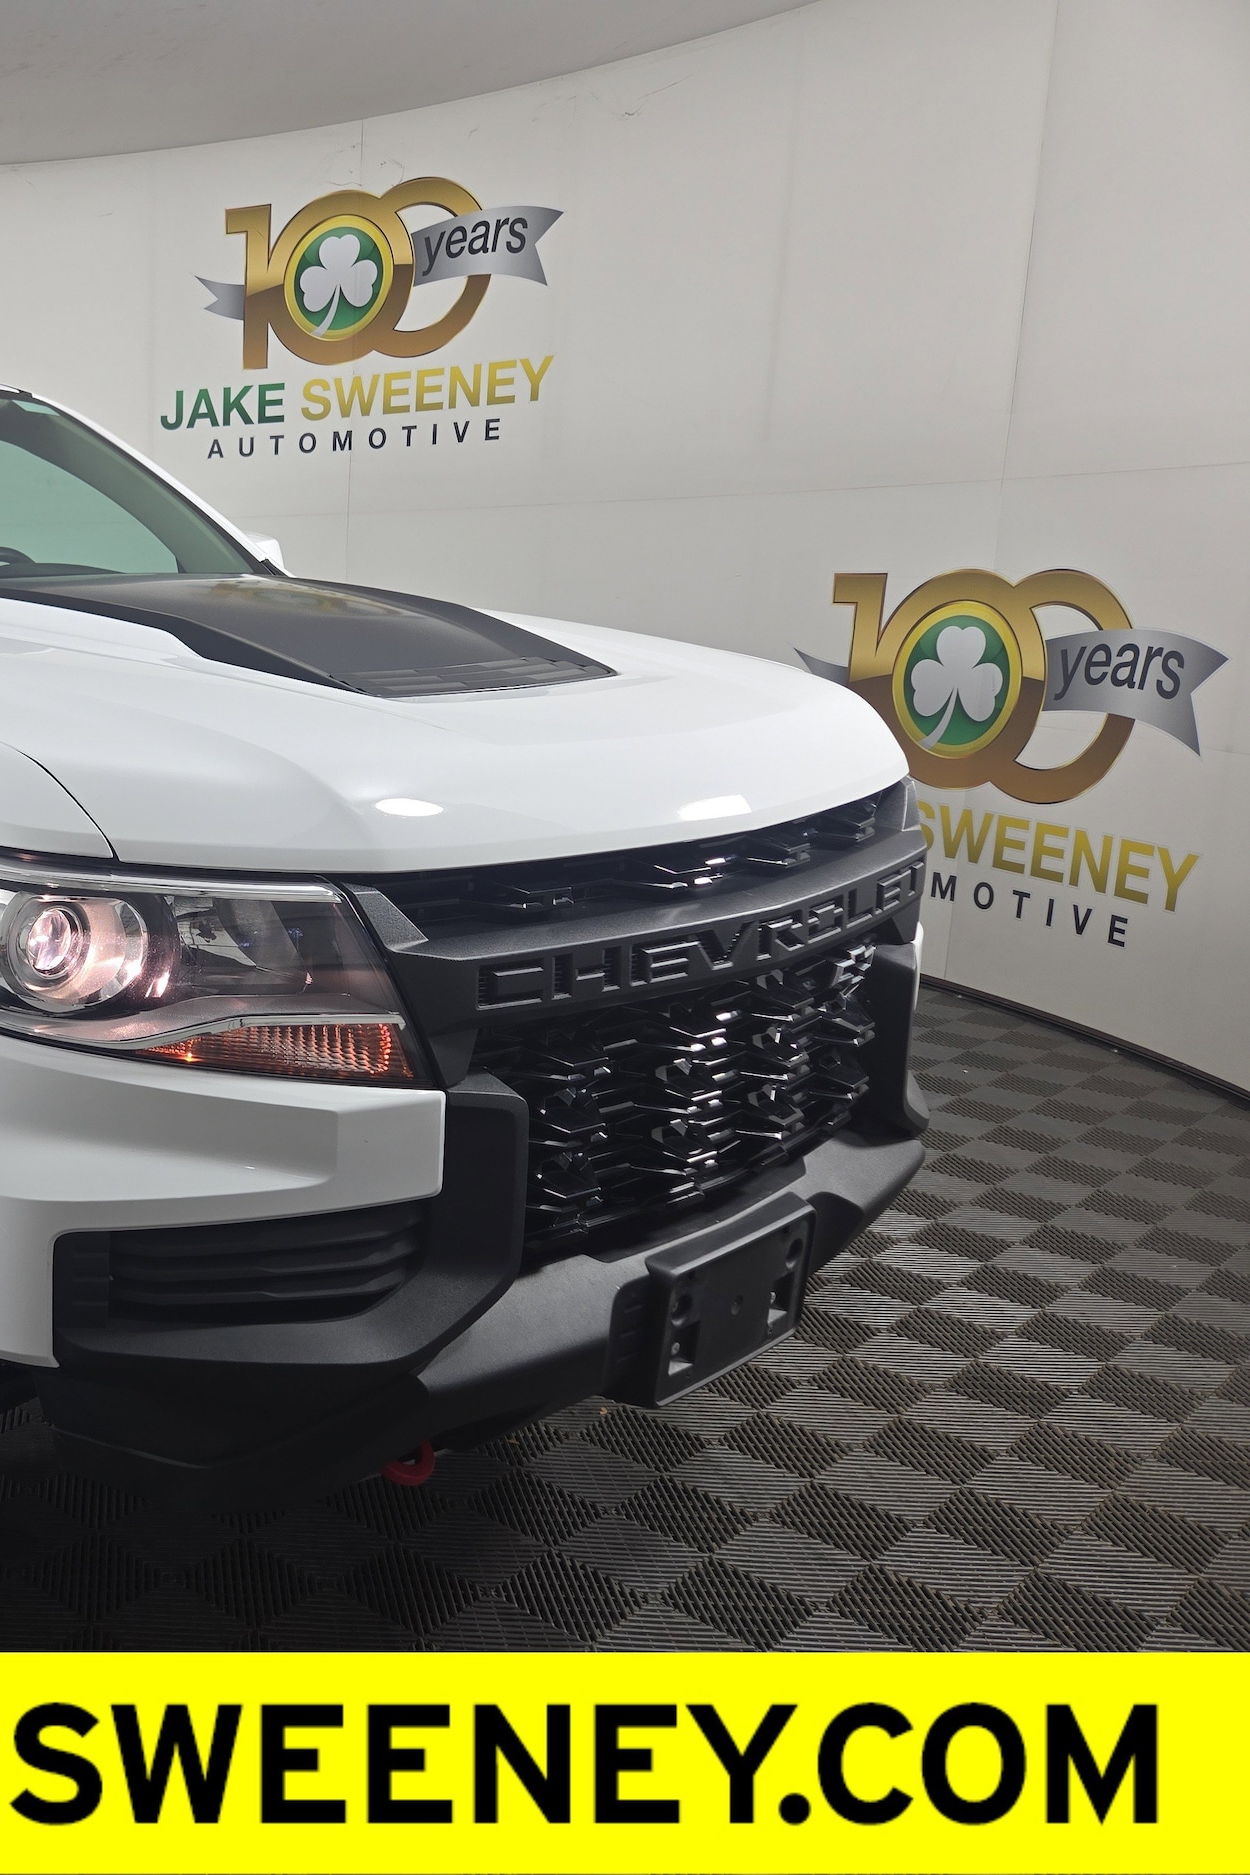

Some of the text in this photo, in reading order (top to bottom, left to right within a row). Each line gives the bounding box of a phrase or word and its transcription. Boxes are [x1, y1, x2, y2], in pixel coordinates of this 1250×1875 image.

[224, 176, 528, 370] 100 years
[160, 354, 555, 431] JAKE SWEENEY
[207, 418, 501, 460] AUTOMOTIVE
[831, 568, 1185, 804] 100 years
[478, 860, 925, 1010] CHEVROLET
[930, 871, 1129, 948] MOTIVE
